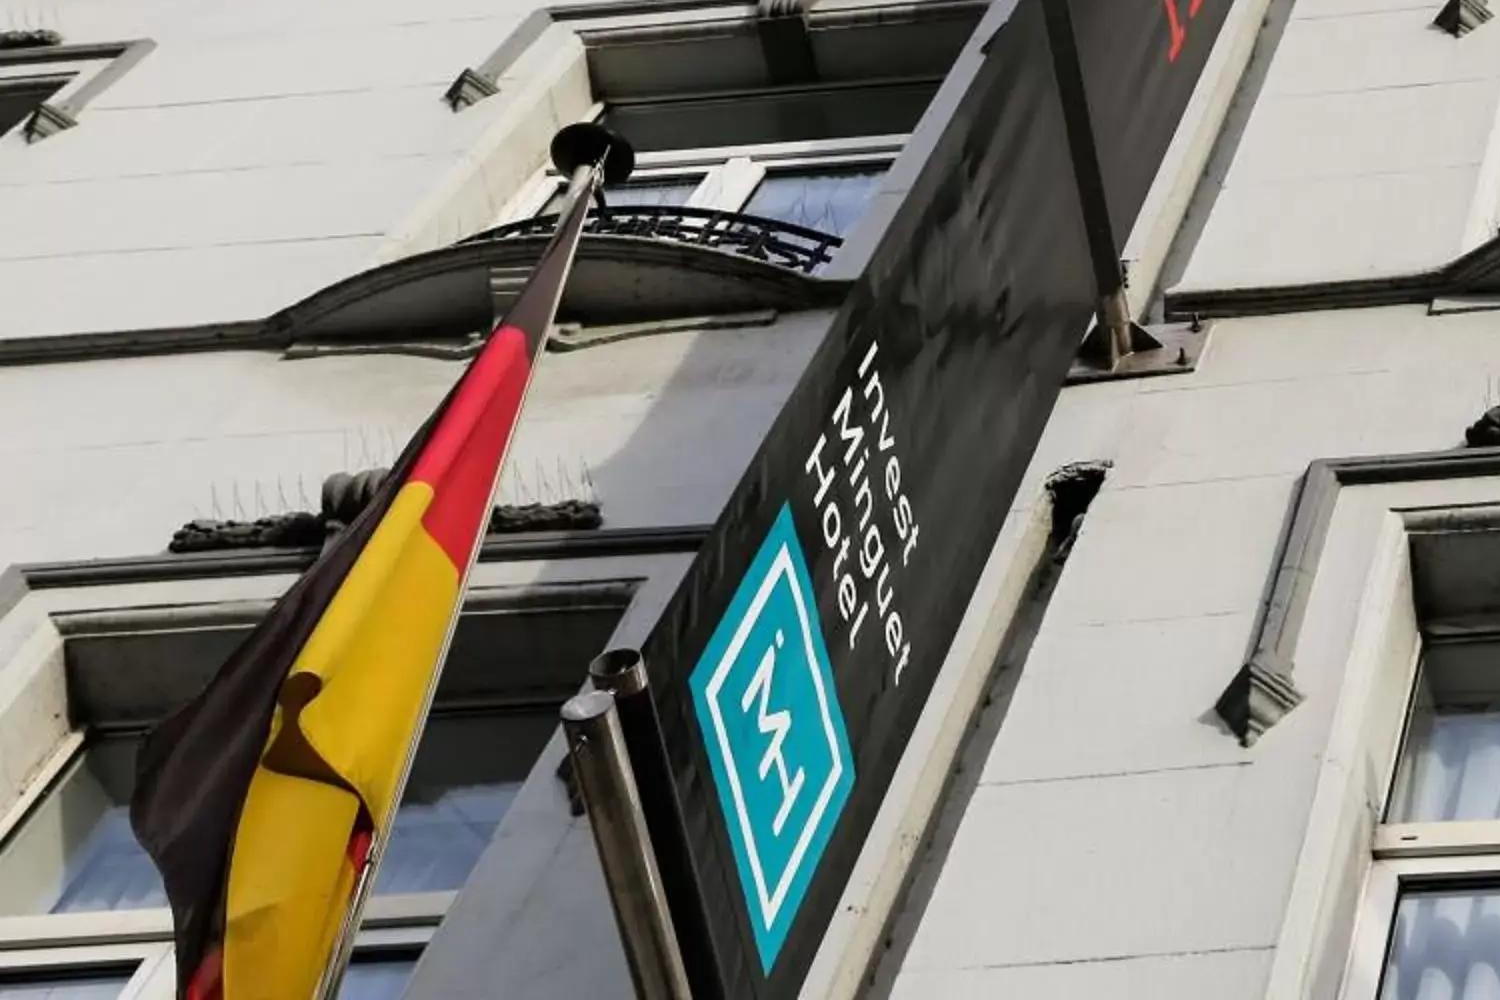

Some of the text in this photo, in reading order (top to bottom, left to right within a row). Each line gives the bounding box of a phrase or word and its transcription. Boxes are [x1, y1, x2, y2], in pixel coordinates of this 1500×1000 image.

[804, 432, 869, 650] Hotel
[831, 385, 911, 687] Minguet
[858, 340, 919, 568] Invest
